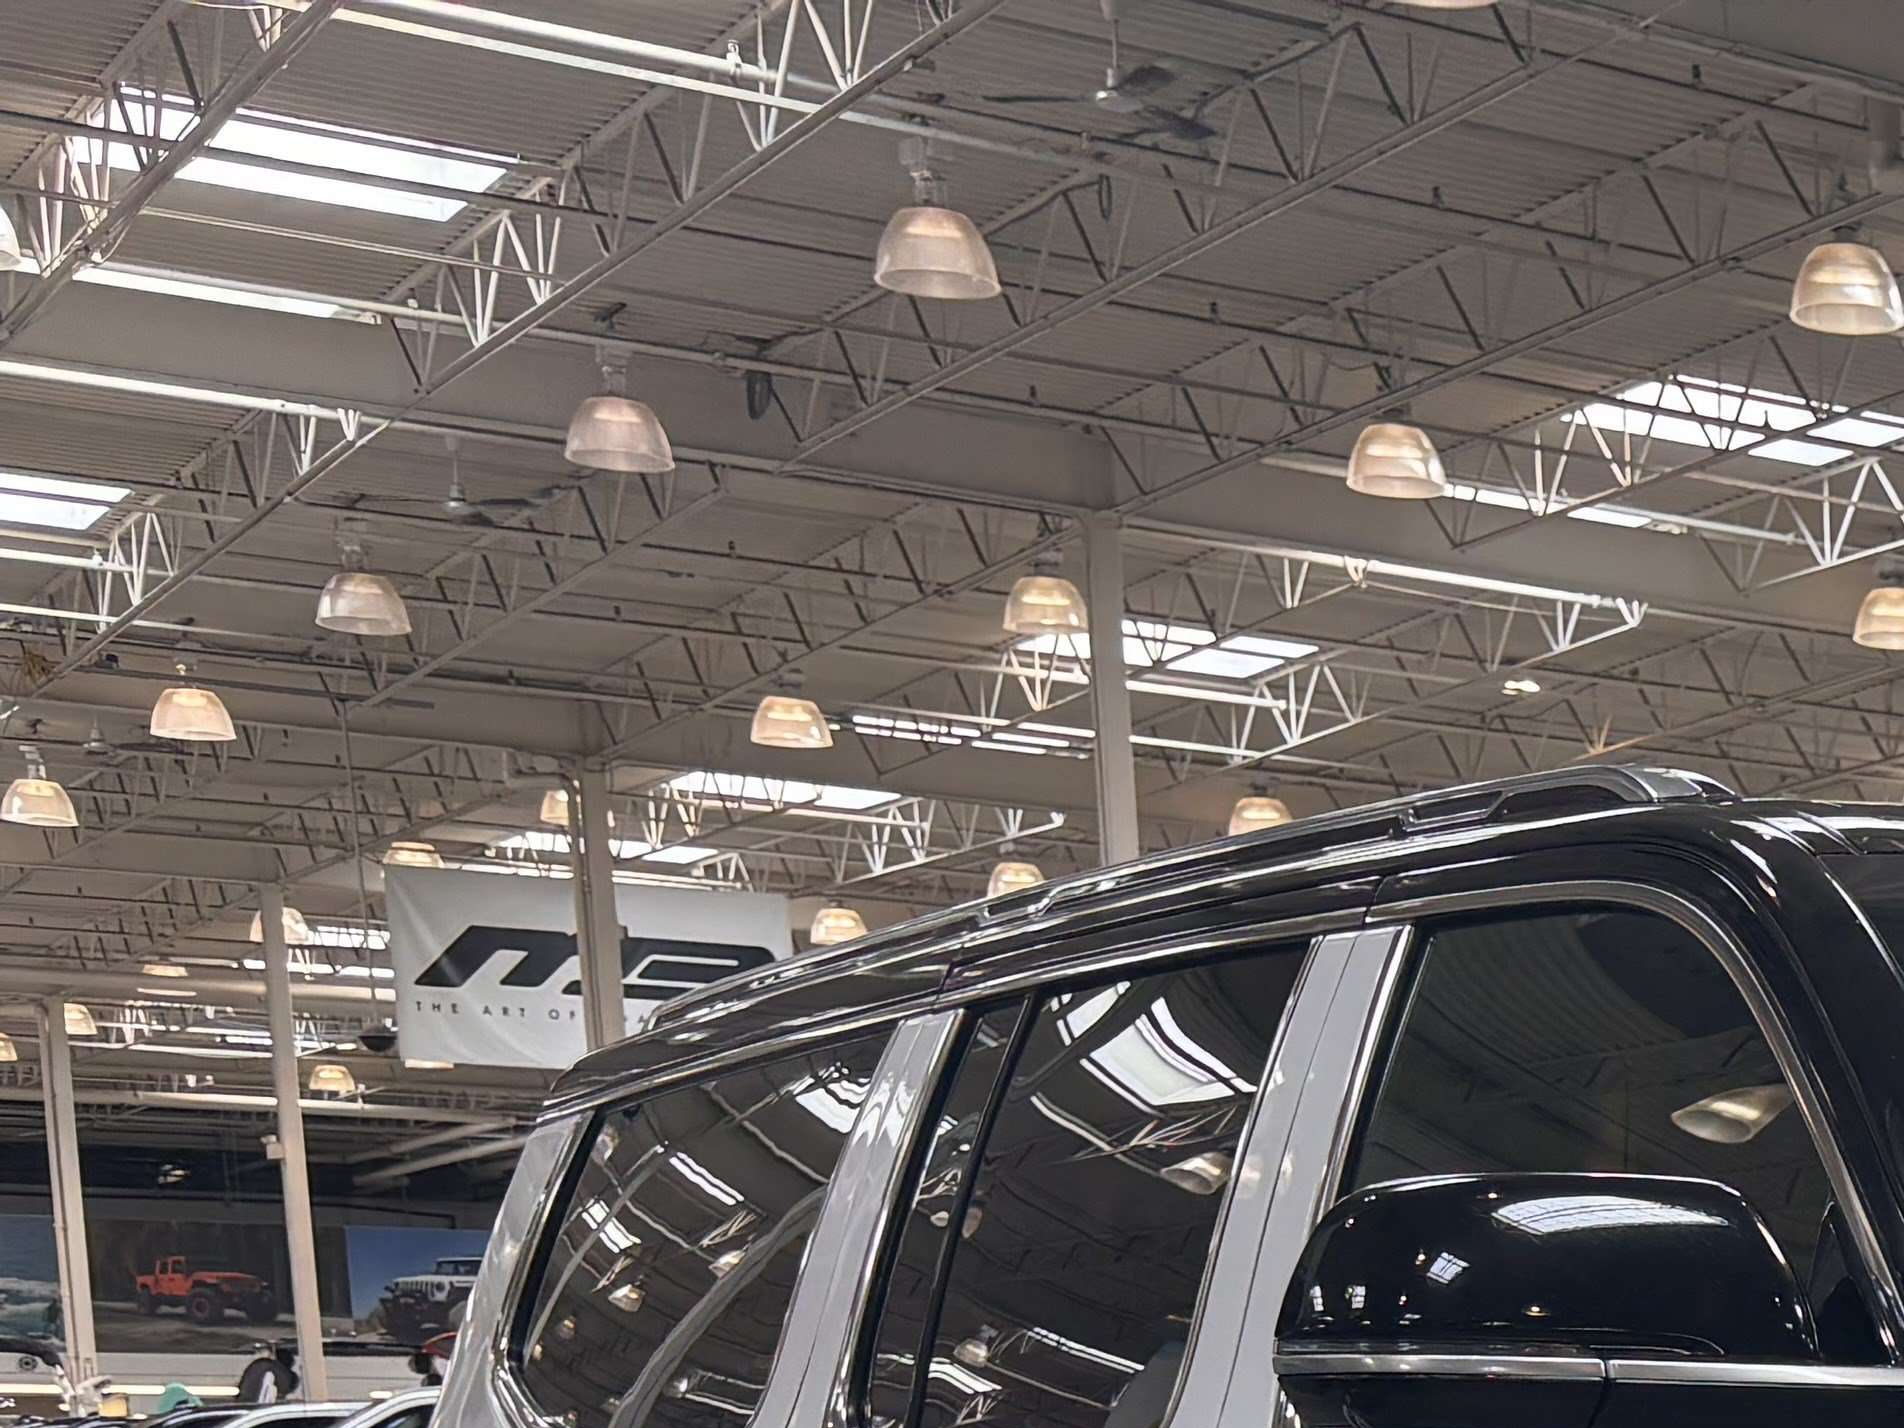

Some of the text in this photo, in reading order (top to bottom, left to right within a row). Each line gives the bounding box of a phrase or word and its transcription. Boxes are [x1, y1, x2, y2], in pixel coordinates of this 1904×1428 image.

[415, 1001, 576, 1021] THE ART OF
